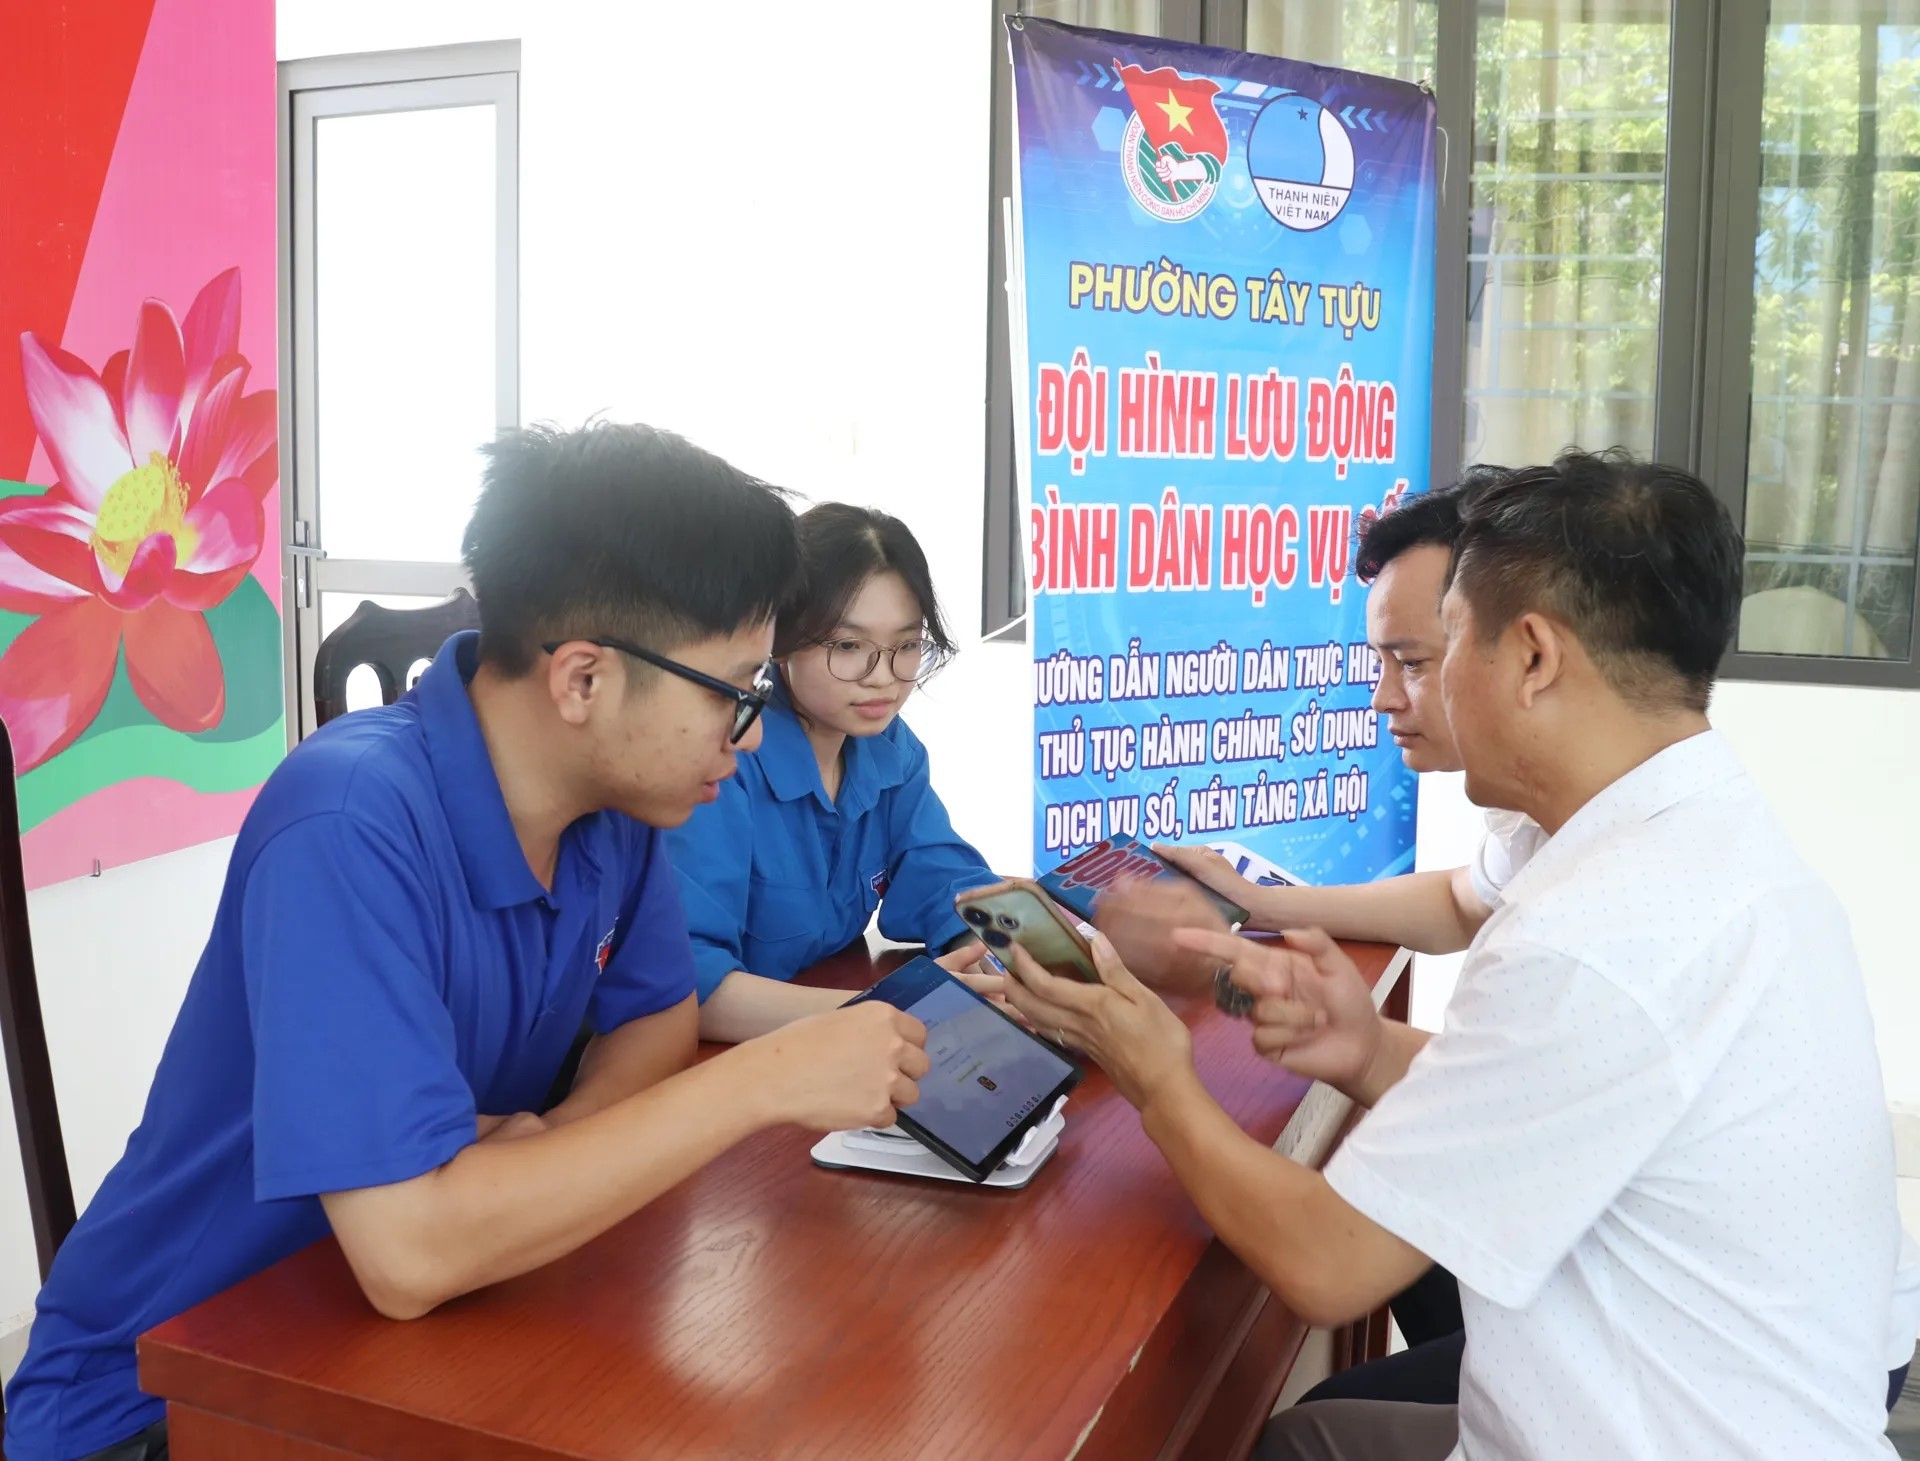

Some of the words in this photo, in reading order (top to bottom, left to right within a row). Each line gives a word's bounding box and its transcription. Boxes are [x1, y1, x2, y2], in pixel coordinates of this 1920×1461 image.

[1268, 187, 1308, 203] THANH
[1312, 192, 1339, 208] NIÊN
[1275, 203, 1302, 219] VIỆT
[1304, 208, 1329, 221] NAM
[1069, 255, 1239, 320] PHƯỜNG
[1245, 268, 1312, 326] TÂY
[1319, 281, 1381, 340] TỰU
[1038, 349, 1107, 473] ĐỘI
[1118, 353, 1217, 459] HÌNH
[1225, 369, 1298, 460] LƯU
[1306, 364, 1397, 477] ĐỘNG
[1128, 489, 1213, 590] DÂN
[1222, 505, 1299, 606] HỌC
[1309, 506, 1351, 604] VỤ
[1109, 637, 1159, 702] DẪN
[1166, 640, 1237, 698] NGƯỜI
[1243, 644, 1288, 692] DÂN
[1294, 641, 1343, 694] THỰC
[1039, 714, 1085, 778] THỦ
[1090, 724, 1136, 782] TỤC
[1141, 713, 1207, 770] HÀNH
[1212, 708, 1286, 763] CHÍNH,
[1290, 698, 1321, 756] SỬ
[1321, 706, 1378, 760] DỤNG
[1045, 799, 1103, 858] DỊCH
[1143, 777, 1183, 842] SỐ,
[1188, 774, 1238, 834] NỀN
[1242, 769, 1298, 828] TẢNG
[1300, 768, 1329, 821] XÃ
[1332, 764, 1368, 823] HỘI
